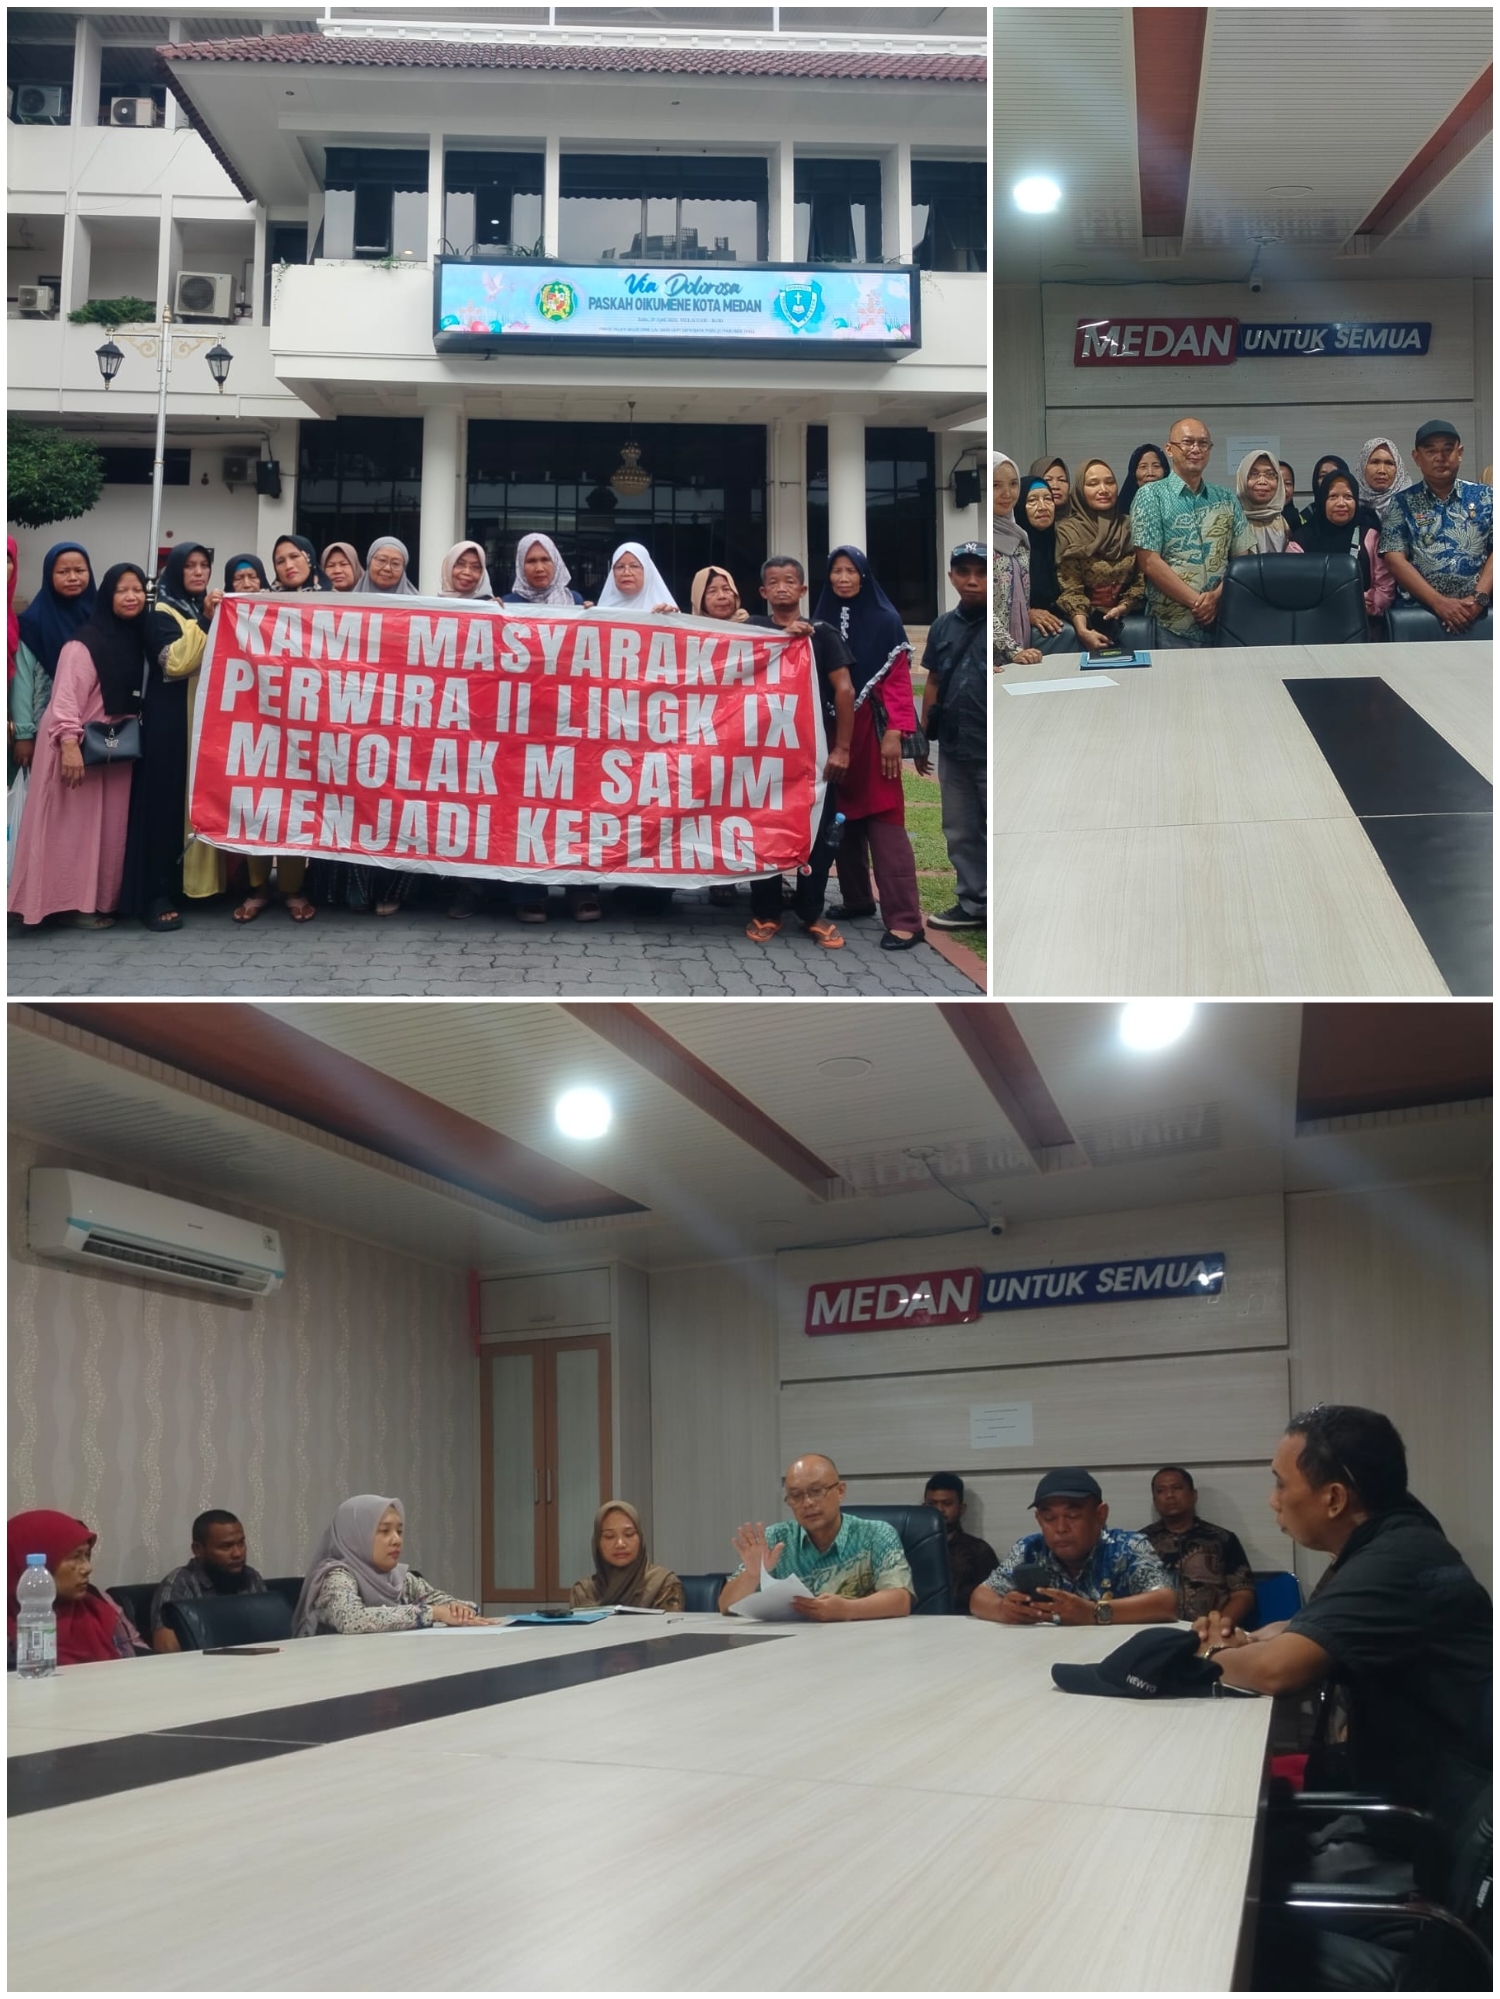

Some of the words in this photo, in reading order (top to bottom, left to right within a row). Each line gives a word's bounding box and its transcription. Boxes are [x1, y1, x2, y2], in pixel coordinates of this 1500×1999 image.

[588, 296, 633, 311] PASKAH
[634, 297, 691, 311] OIKUMENE
[692, 298, 721, 312] KOTA
[722, 299, 762, 313] MEDAN
[624, 273, 659, 295] Via
[664, 272, 743, 297] Dolorosa
[1081, 324, 1233, 358] MEDAN
[1243, 328, 1329, 351] UNTUK
[1333, 327, 1423, 351] SEMUA
[235, 602, 383, 663] KAMI
[406, 614, 788, 686] MASYARAKAT
[220, 658, 471, 731] PERWIRA
[495, 680, 532, 735] II
[555, 684, 719, 746] LINGK
[743, 693, 801, 749] IX
[225, 721, 500, 795] MENOLAK
[523, 743, 576, 801] M
[600, 749, 784, 811] SALIM
[226, 786, 491, 860] MENJADI
[515, 806, 779, 872] KEPLING.
[810, 1276, 974, 1326] MEDAN
[986, 1271, 1088, 1303] UNTUK
[1095, 1260, 1210, 1293] SEMUA
